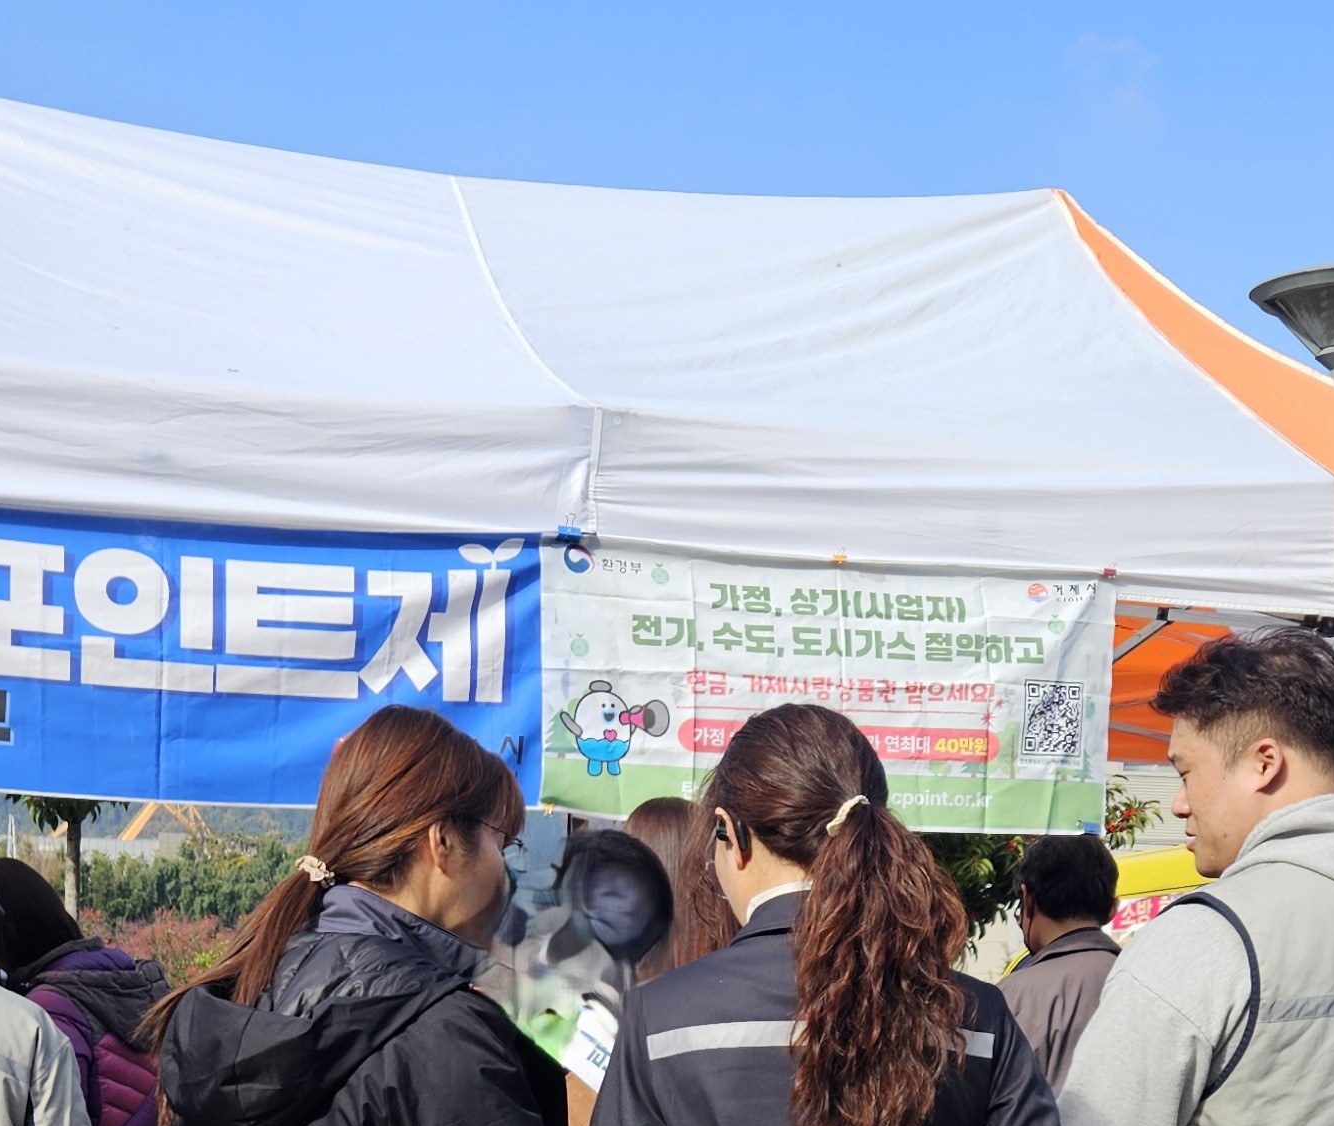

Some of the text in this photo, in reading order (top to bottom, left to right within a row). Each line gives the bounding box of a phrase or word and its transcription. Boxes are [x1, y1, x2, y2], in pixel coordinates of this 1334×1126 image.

[601, 558, 643, 574] 환경부
[710, 583, 966, 623] 가정, 상가(사업자)
[632, 614, 1045, 664] 전기, 수도, 도시가스 절약하고
[687, 669, 995, 704] 현금, 거제사랑상품권 받으세요!
[694, 727, 725, 746] 가정
[884, 735, 931, 755] 연최대
[934, 737, 988, 756] 40만원
[890, 790, 994, 809] cpoint.or.kr
